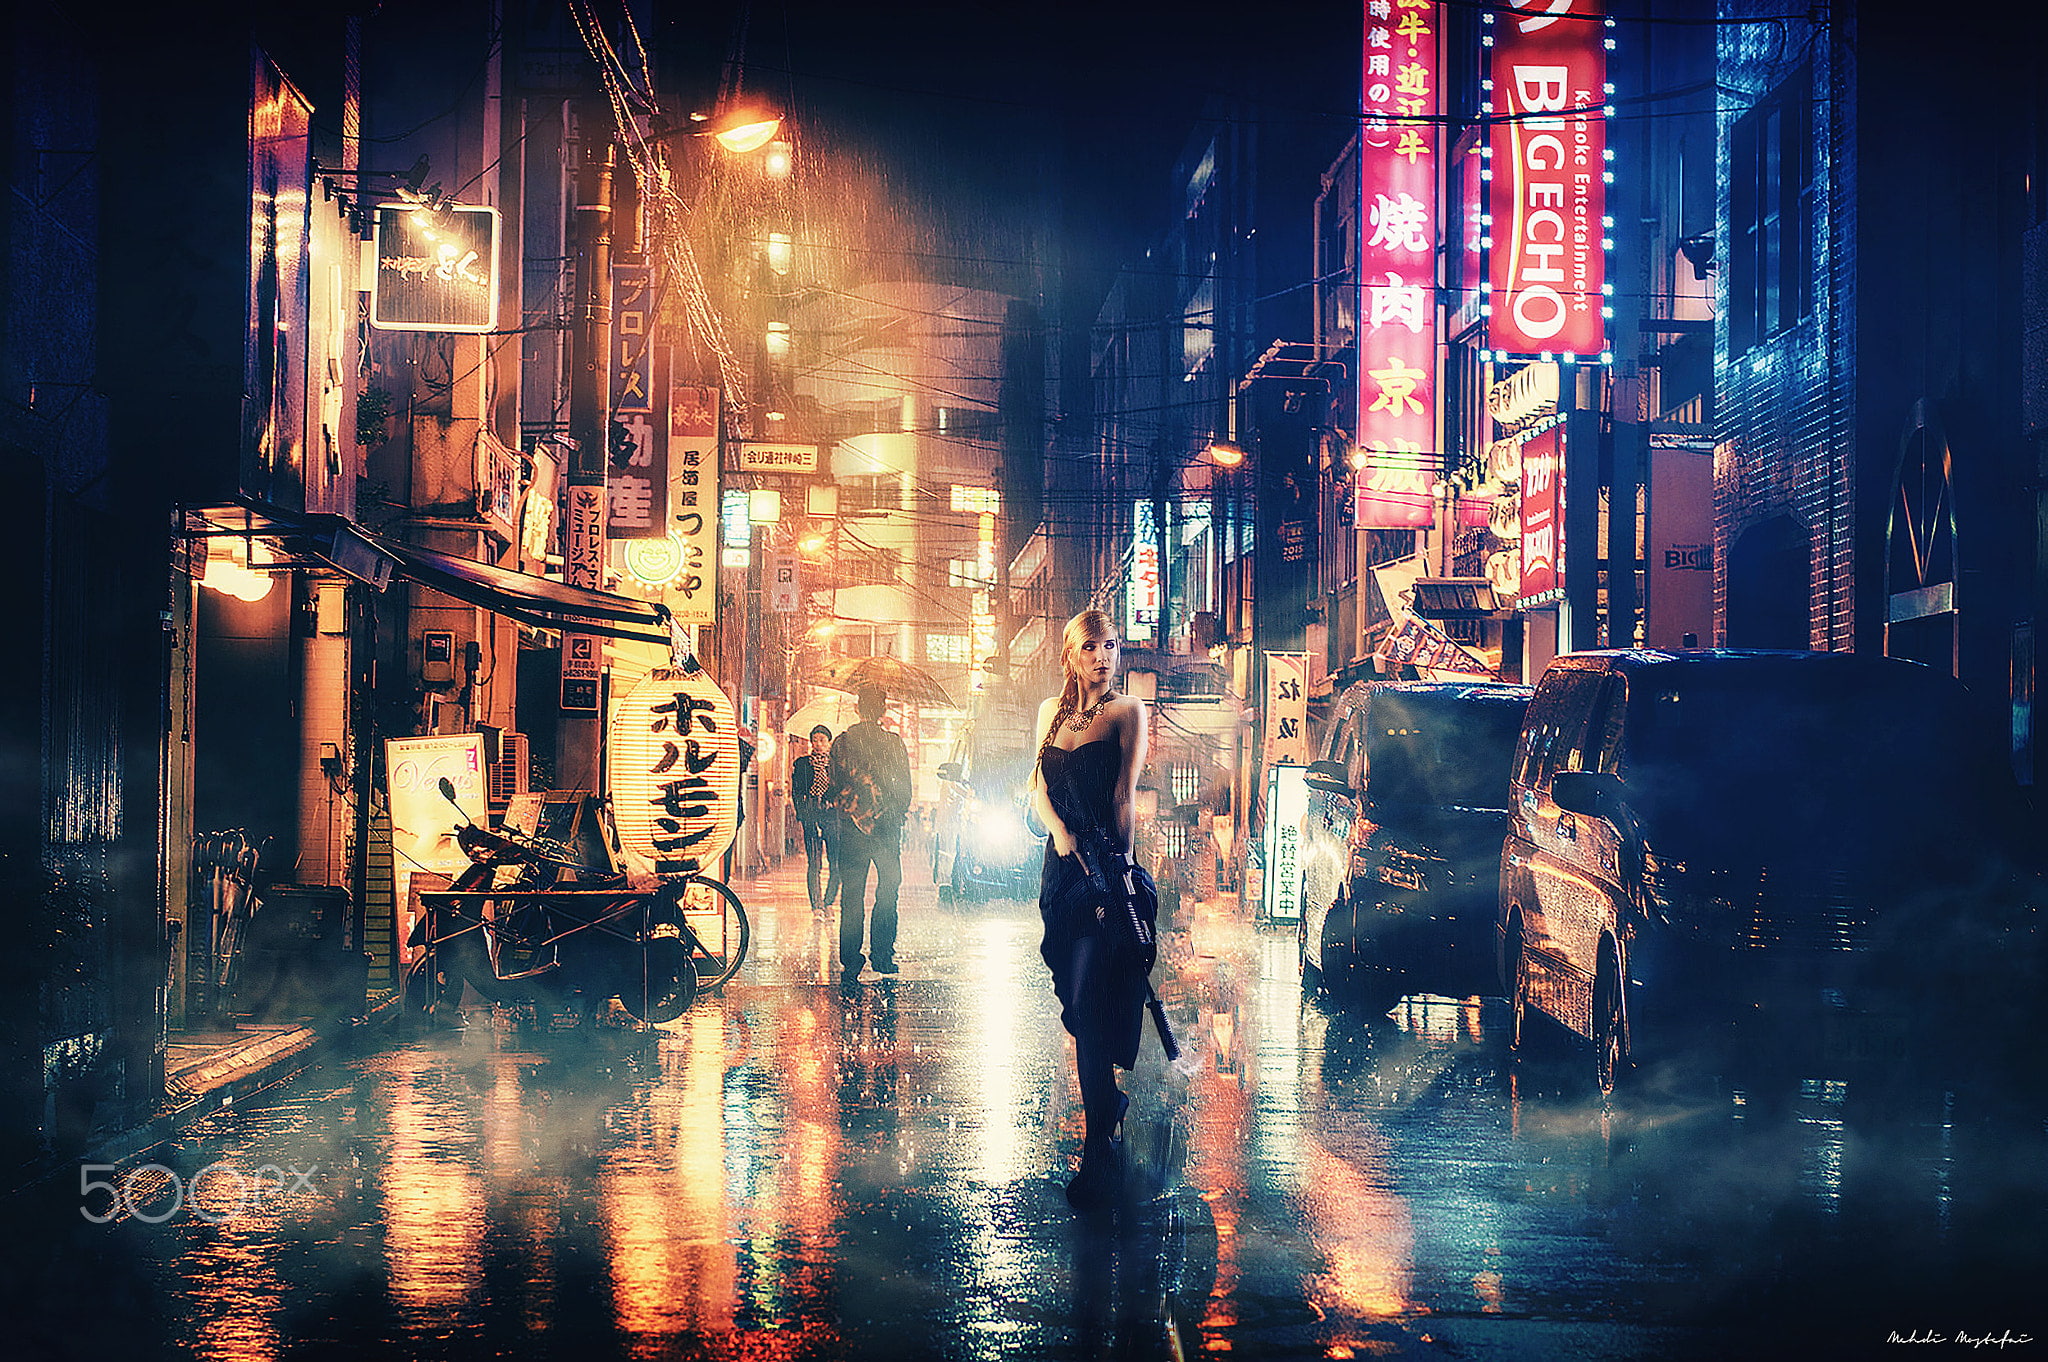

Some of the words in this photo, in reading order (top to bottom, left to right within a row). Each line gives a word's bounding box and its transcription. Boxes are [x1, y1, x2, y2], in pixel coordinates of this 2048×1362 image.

[1513, 65, 1568, 171] BIG
[1573, 89, 1591, 166] Karaoke
[1512, 182, 1567, 339] ECHO
[1572, 173, 1591, 312] Entertainment
[619, 275, 648, 400] プロレス
[650, 692, 719, 853] ホルモン
